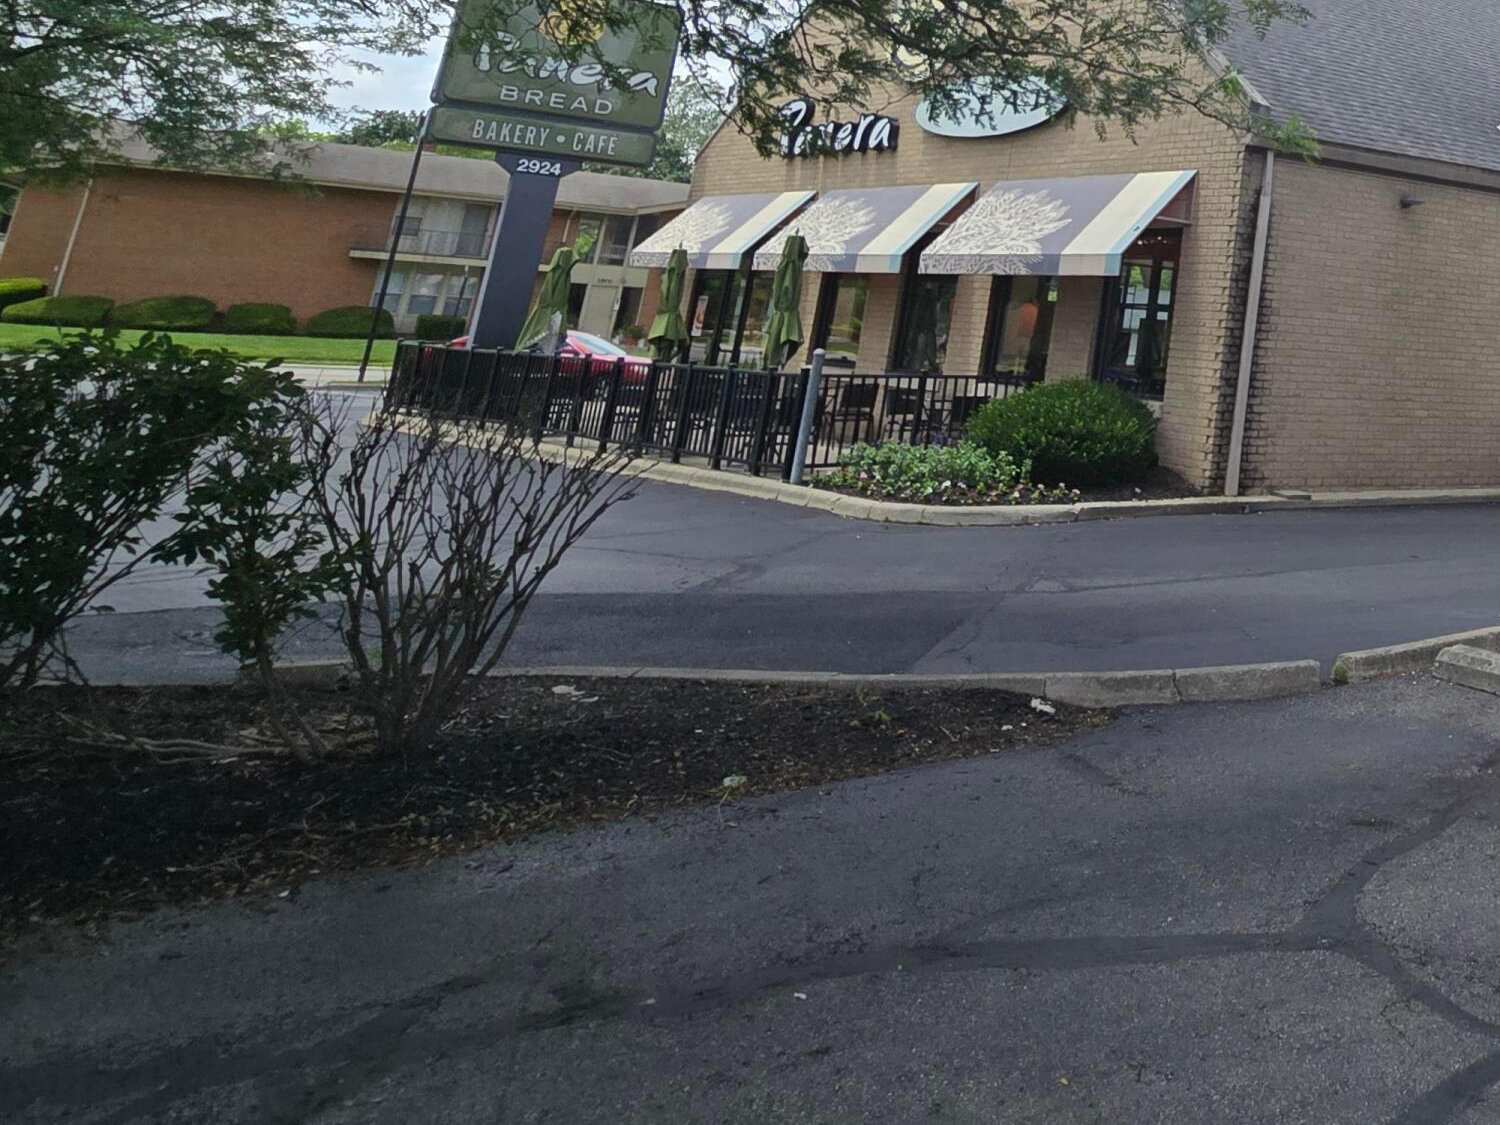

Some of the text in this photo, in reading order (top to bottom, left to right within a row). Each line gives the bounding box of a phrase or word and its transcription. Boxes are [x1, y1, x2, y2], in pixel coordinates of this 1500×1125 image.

[499, 85, 614, 115] BREAD
[472, 119, 550, 147] BAKERY
[516, 158, 561, 176] 2924
